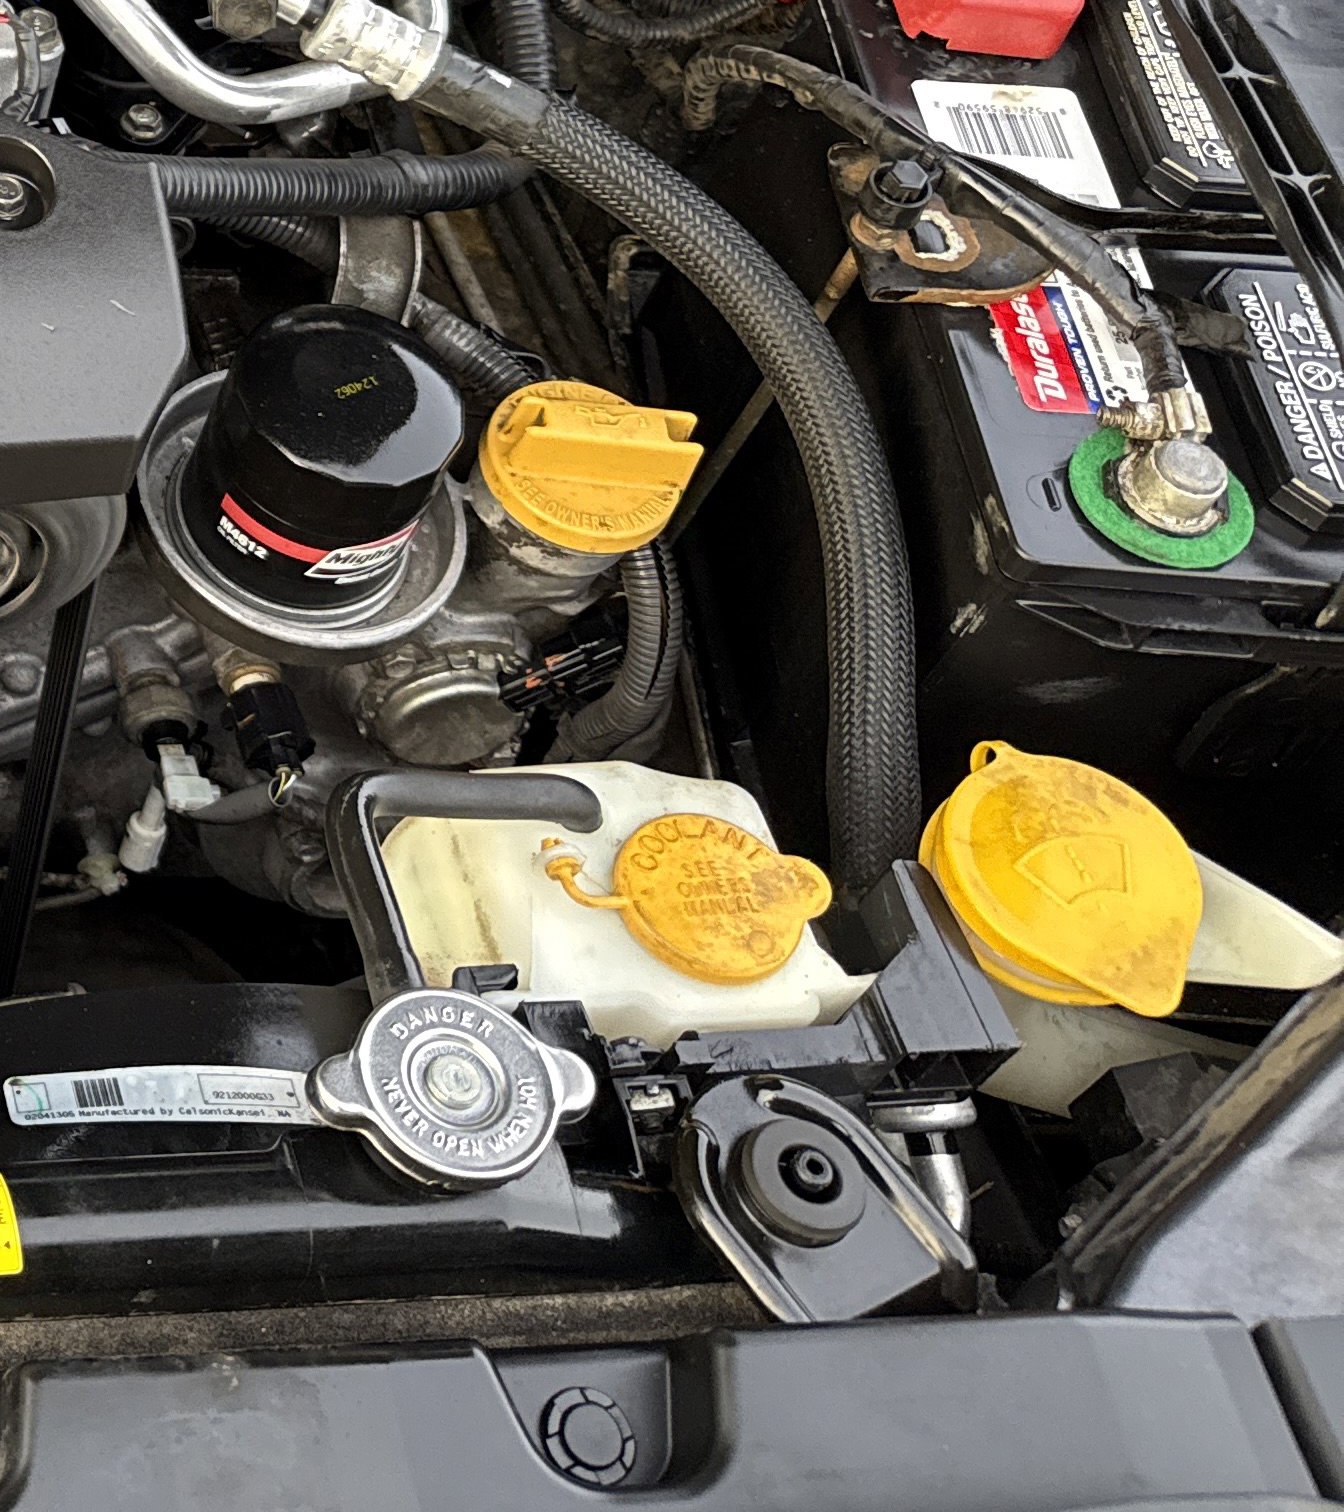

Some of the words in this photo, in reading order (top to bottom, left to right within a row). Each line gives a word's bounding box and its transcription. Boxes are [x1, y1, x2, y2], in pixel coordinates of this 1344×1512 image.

[1053, 301, 1079, 345] TOUGH
[1238, 293, 1283, 363] POISON
[1071, 347, 1100, 402] PROVEN
[1097, 354, 1114, 383] Return
[1275, 381, 1325, 461] DANGER
[515, 478, 545, 506] SEE
[546, 500, 614, 532] OWNER'S
[630, 818, 770, 872] COOLANT
[680, 859, 722, 879] SEE
[683, 897, 762, 917] MANUAL
[389, 1006, 495, 1040] DANGER
[78, 1107, 156, 1118] Manufactured
[161, 1105, 173, 1117] by
[381, 1076, 430, 1137] NEVER
[432, 1129, 486, 1160] OPEN
[487, 1111, 534, 1154] WHEN
[515, 1074, 537, 1109] HOT
